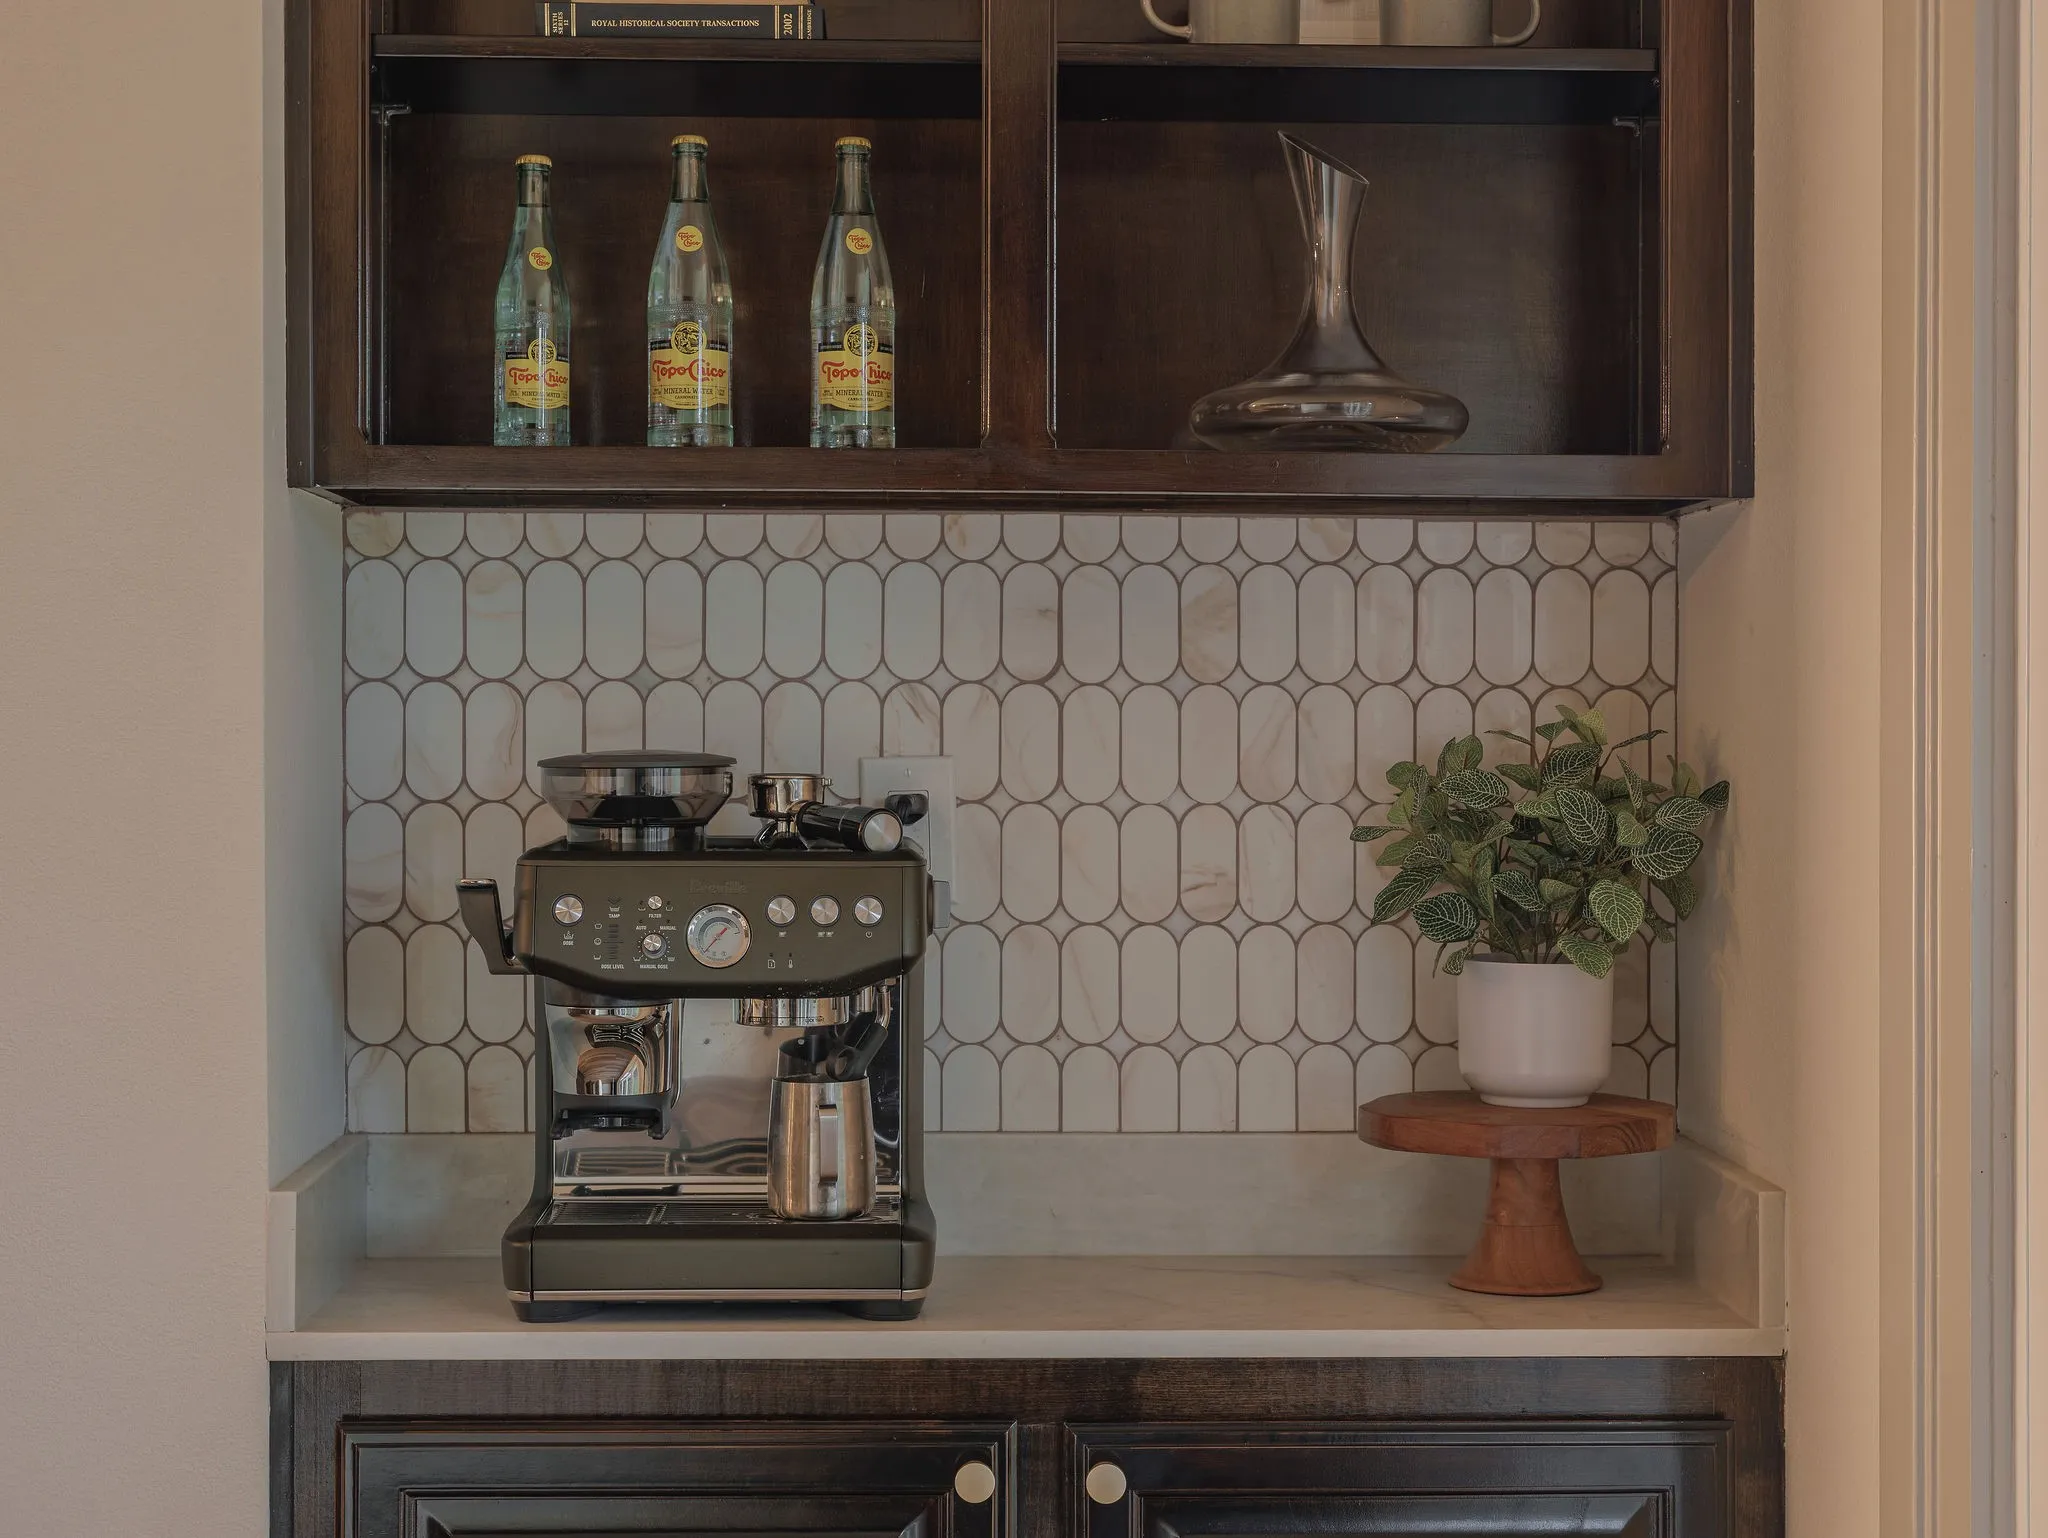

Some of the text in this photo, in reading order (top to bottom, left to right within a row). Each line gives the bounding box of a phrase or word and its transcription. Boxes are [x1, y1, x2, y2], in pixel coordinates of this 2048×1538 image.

[783, 13, 793, 36] 2002
[678, 232, 696, 241] Topo
[848, 234, 866, 243] Topo
[683, 239, 701, 247] Chico
[854, 241, 870, 250] Chico
[652, 358, 726, 382] Topo Chico
[821, 361, 893, 385] Topo Chico
[508, 367, 568, 387] Topo Chico
[663, 387, 691, 395] MINERAL
[692, 387, 713, 395] WTER
